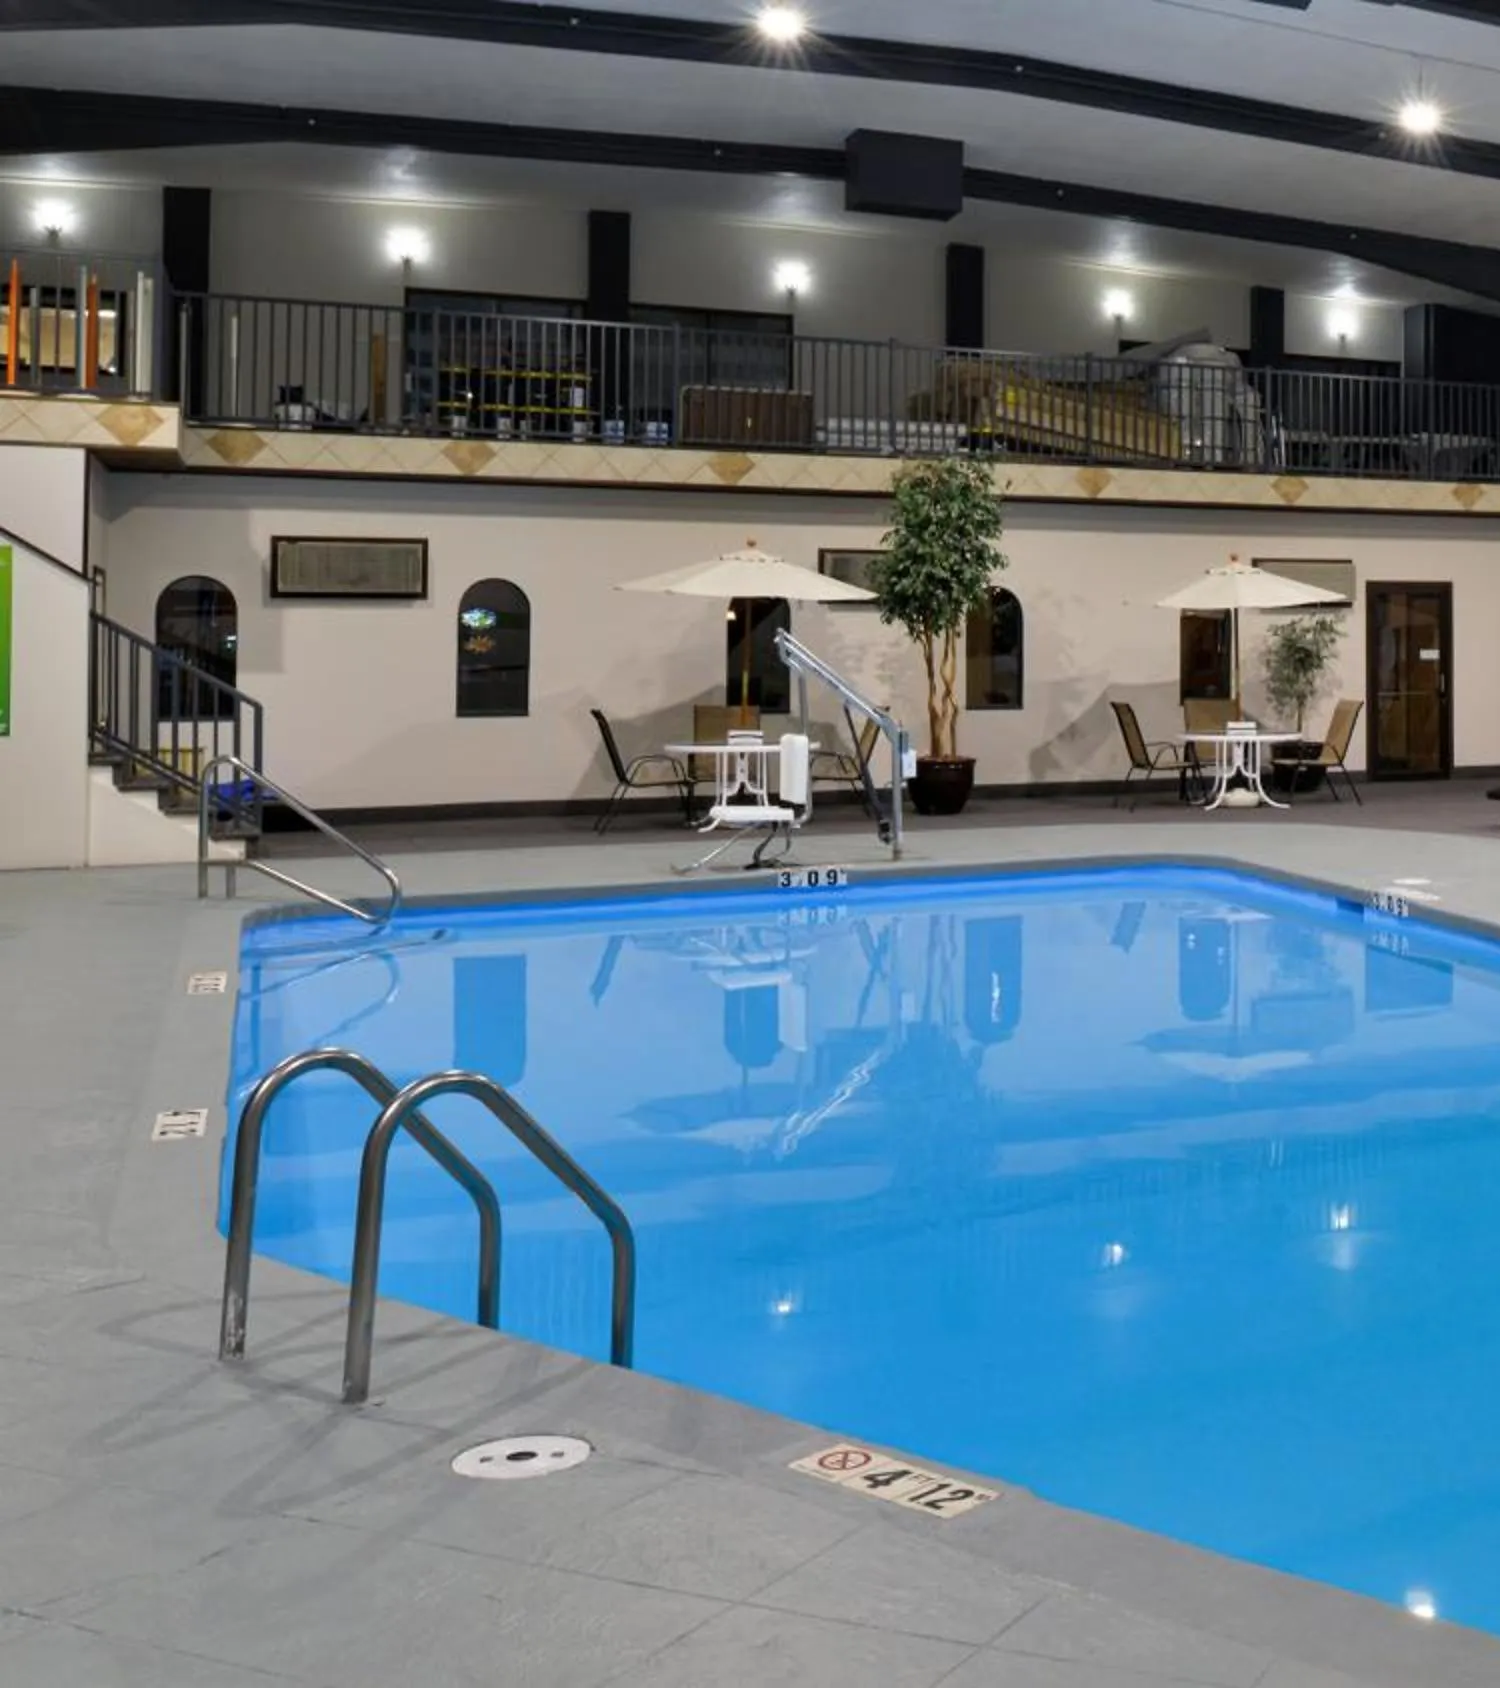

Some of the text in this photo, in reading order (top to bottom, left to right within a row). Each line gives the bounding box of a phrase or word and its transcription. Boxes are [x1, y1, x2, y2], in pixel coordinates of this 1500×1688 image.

[780, 871, 791, 887] 3
[862, 1468, 912, 1489] 4
[909, 1483, 975, 1510] 12
